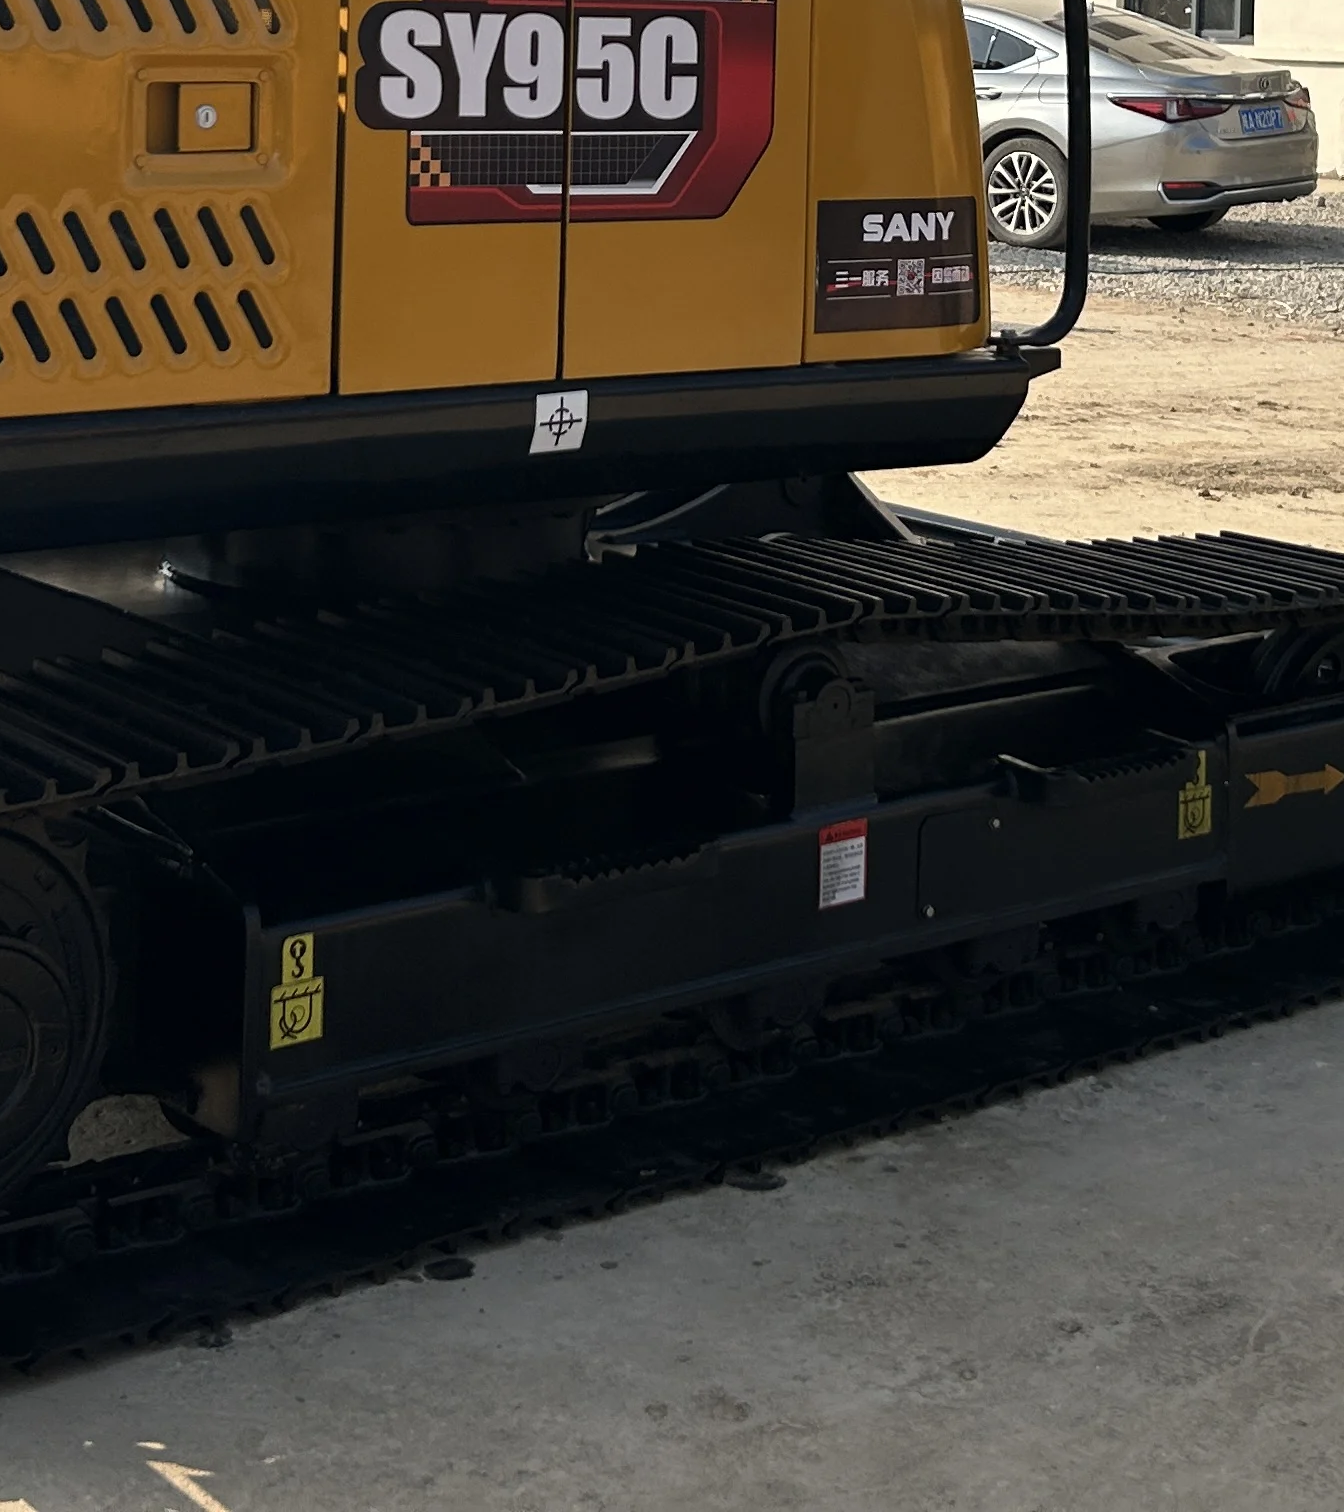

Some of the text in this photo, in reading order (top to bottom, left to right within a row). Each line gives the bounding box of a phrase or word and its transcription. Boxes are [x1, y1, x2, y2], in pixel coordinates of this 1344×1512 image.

[378, 7, 700, 121] SY95C
[862, 211, 955, 243] SANY
[834, 269, 890, 289] 三一服务
